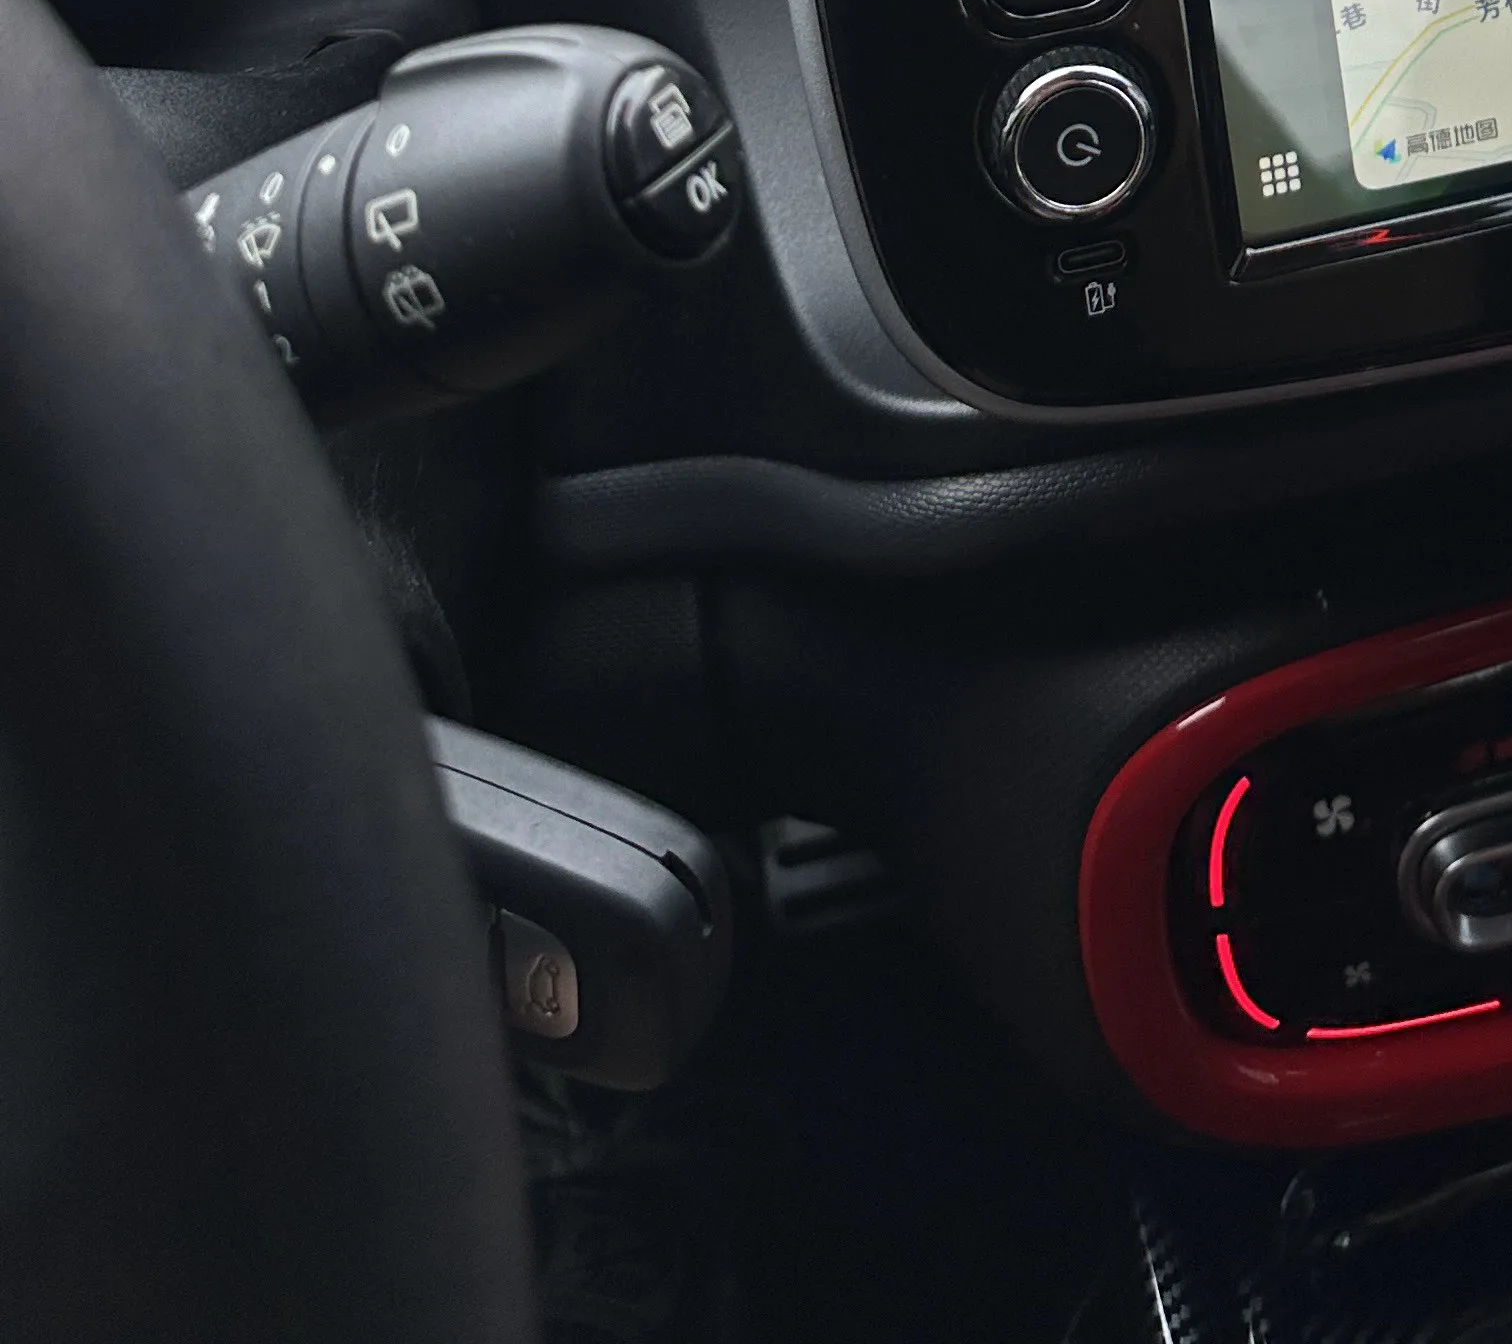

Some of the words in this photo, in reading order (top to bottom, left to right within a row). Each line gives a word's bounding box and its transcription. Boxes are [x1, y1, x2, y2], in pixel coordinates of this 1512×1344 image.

[1335, 2, 1367, 34] 巷
[1406, 117, 1498, 157] 高德地图
[685, 159, 728, 214] OK
